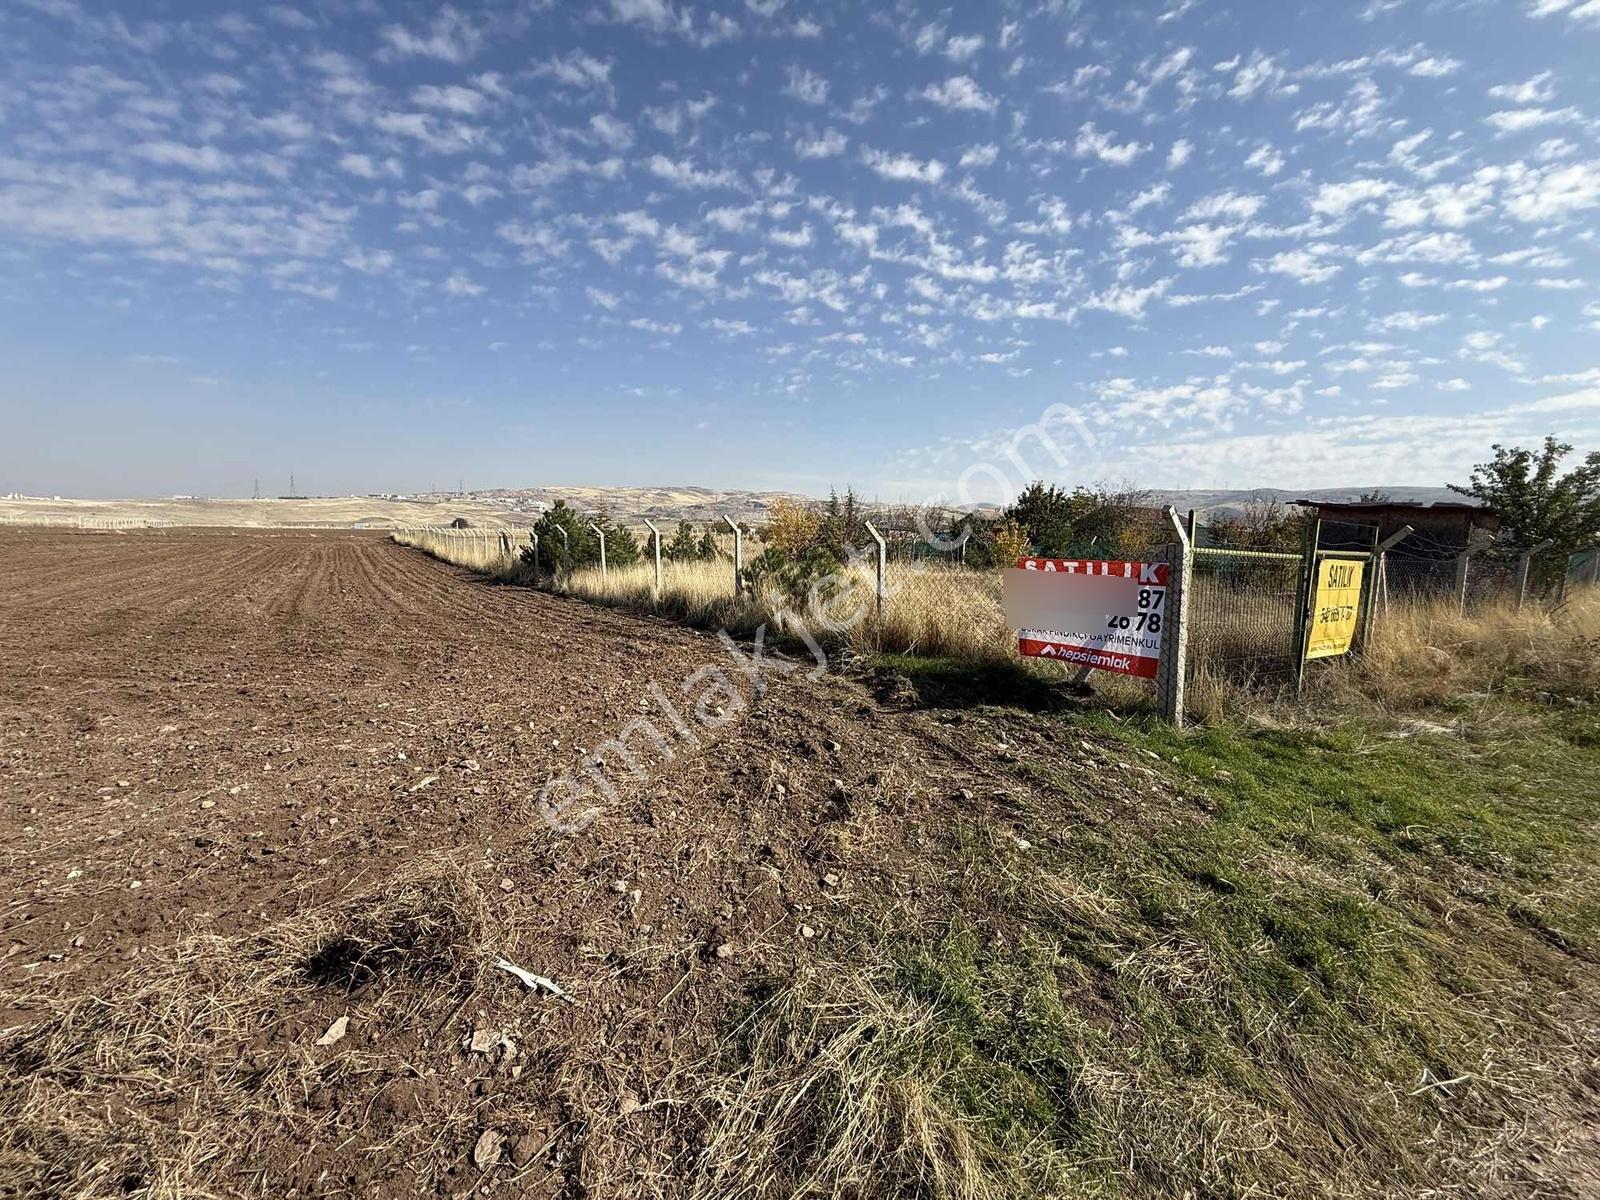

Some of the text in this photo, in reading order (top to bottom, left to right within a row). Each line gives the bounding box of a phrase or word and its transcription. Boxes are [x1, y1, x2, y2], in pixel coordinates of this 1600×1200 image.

[1327, 564, 1354, 589] SATILIK
[1138, 589, 1165, 610] 87
[1135, 611, 1161, 634] 78
[1058, 648, 1130, 670] hepsiemlak
